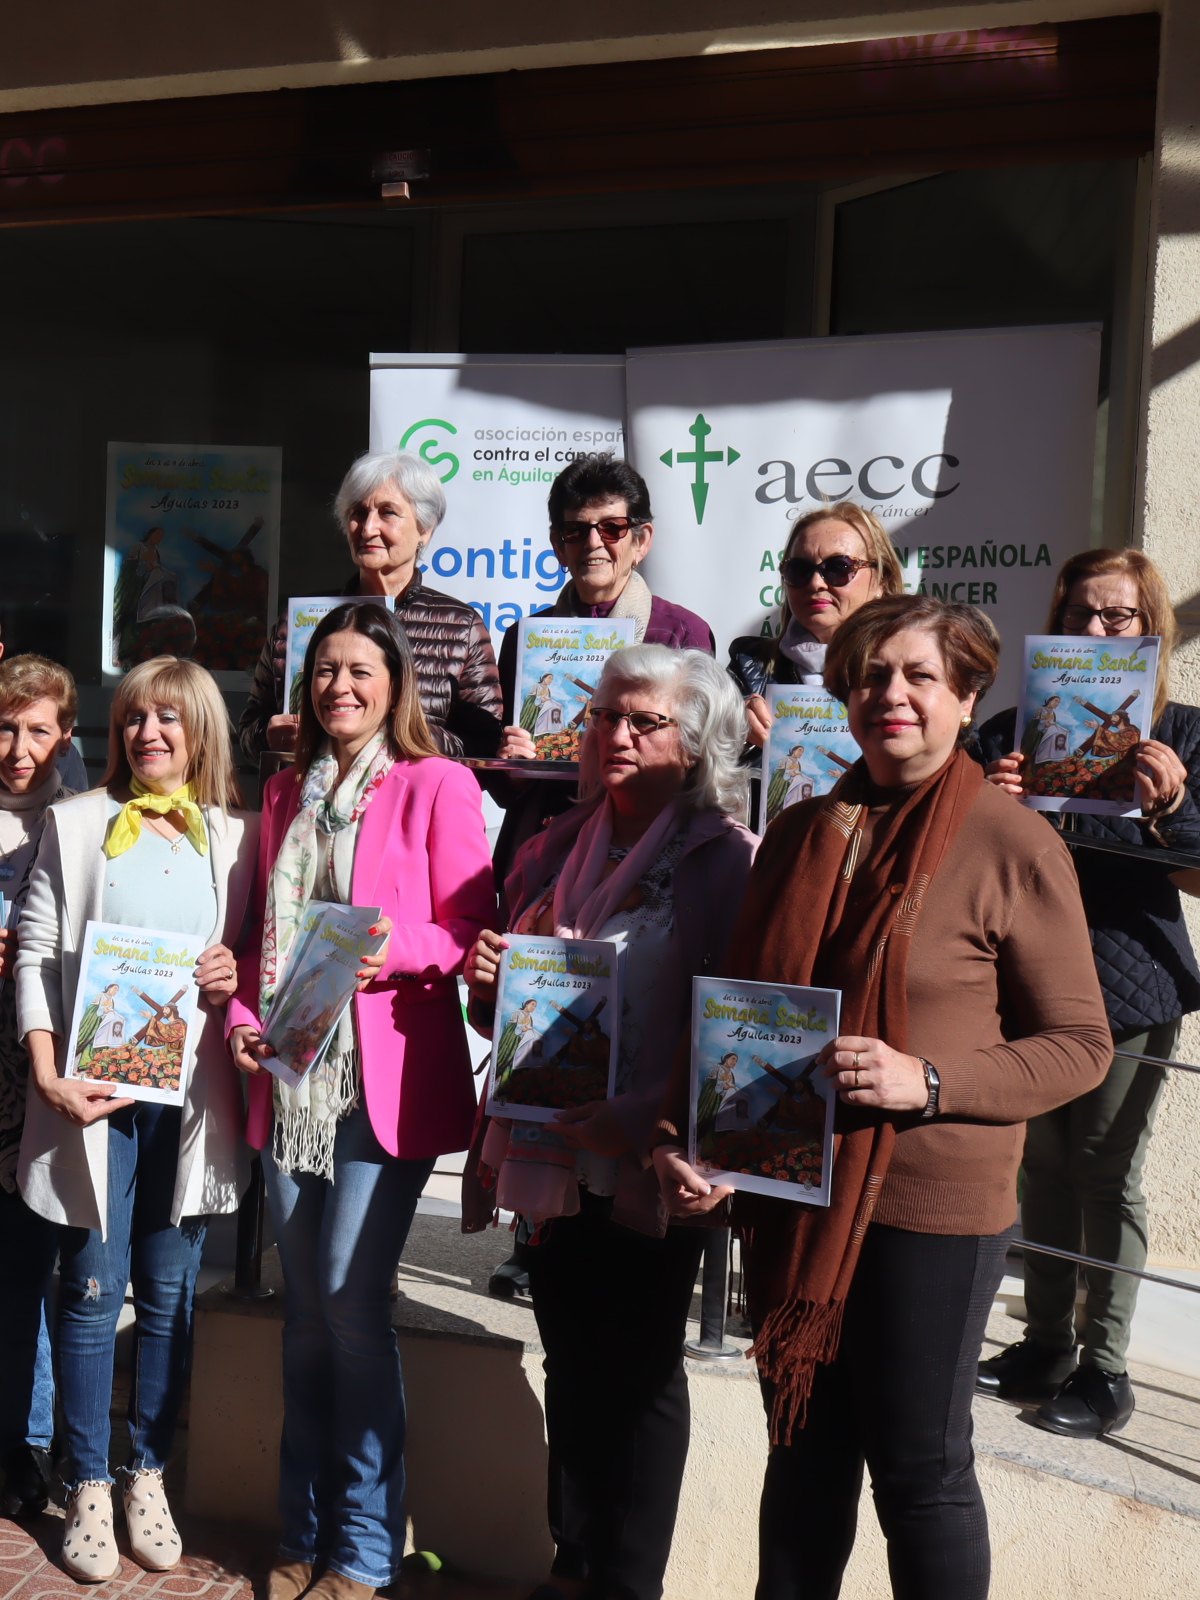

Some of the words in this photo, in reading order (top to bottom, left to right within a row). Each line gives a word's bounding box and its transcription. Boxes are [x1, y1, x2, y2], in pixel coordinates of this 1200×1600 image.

[474, 427, 567, 441] asociación
[473, 448, 529, 461] contra
[534, 448, 549, 461] el
[121, 464, 202, 490] Semana
[208, 464, 269, 493] Santa
[472, 471, 493, 481] en
[754, 453, 961, 504] aecc
[150, 491, 208, 512] Águilas
[212, 499, 239, 509] 2023
[870, 504, 933, 517] Cáncer
[918, 540, 1052, 569] ESPAÑOLA
[526, 632, 579, 649] Semana
[583, 631, 625, 650] Santa
[545, 650, 583, 664] Águilas
[1032, 651, 1093, 670] Semana
[1097, 650, 1146, 672] Santa
[1052, 671, 1096, 686] Águilas
[775, 701, 833, 719] Semana
[795, 720, 838, 735] Águilas
[94, 938, 149, 961] Semana
[153, 947, 195, 968] Santa
[112, 960, 152, 974] Águilas
[154, 969, 173, 977] 2023
[509, 951, 567, 973] Semana
[570, 955, 610, 978] Santa
[529, 973, 570, 989] Águilas
[572, 981, 591, 989] 2023
[703, 998, 770, 1025] Semana
[775, 1006, 827, 1032] Santa
[727, 1024, 775, 1041] Águilas
[779, 1034, 802, 1044] 2023
